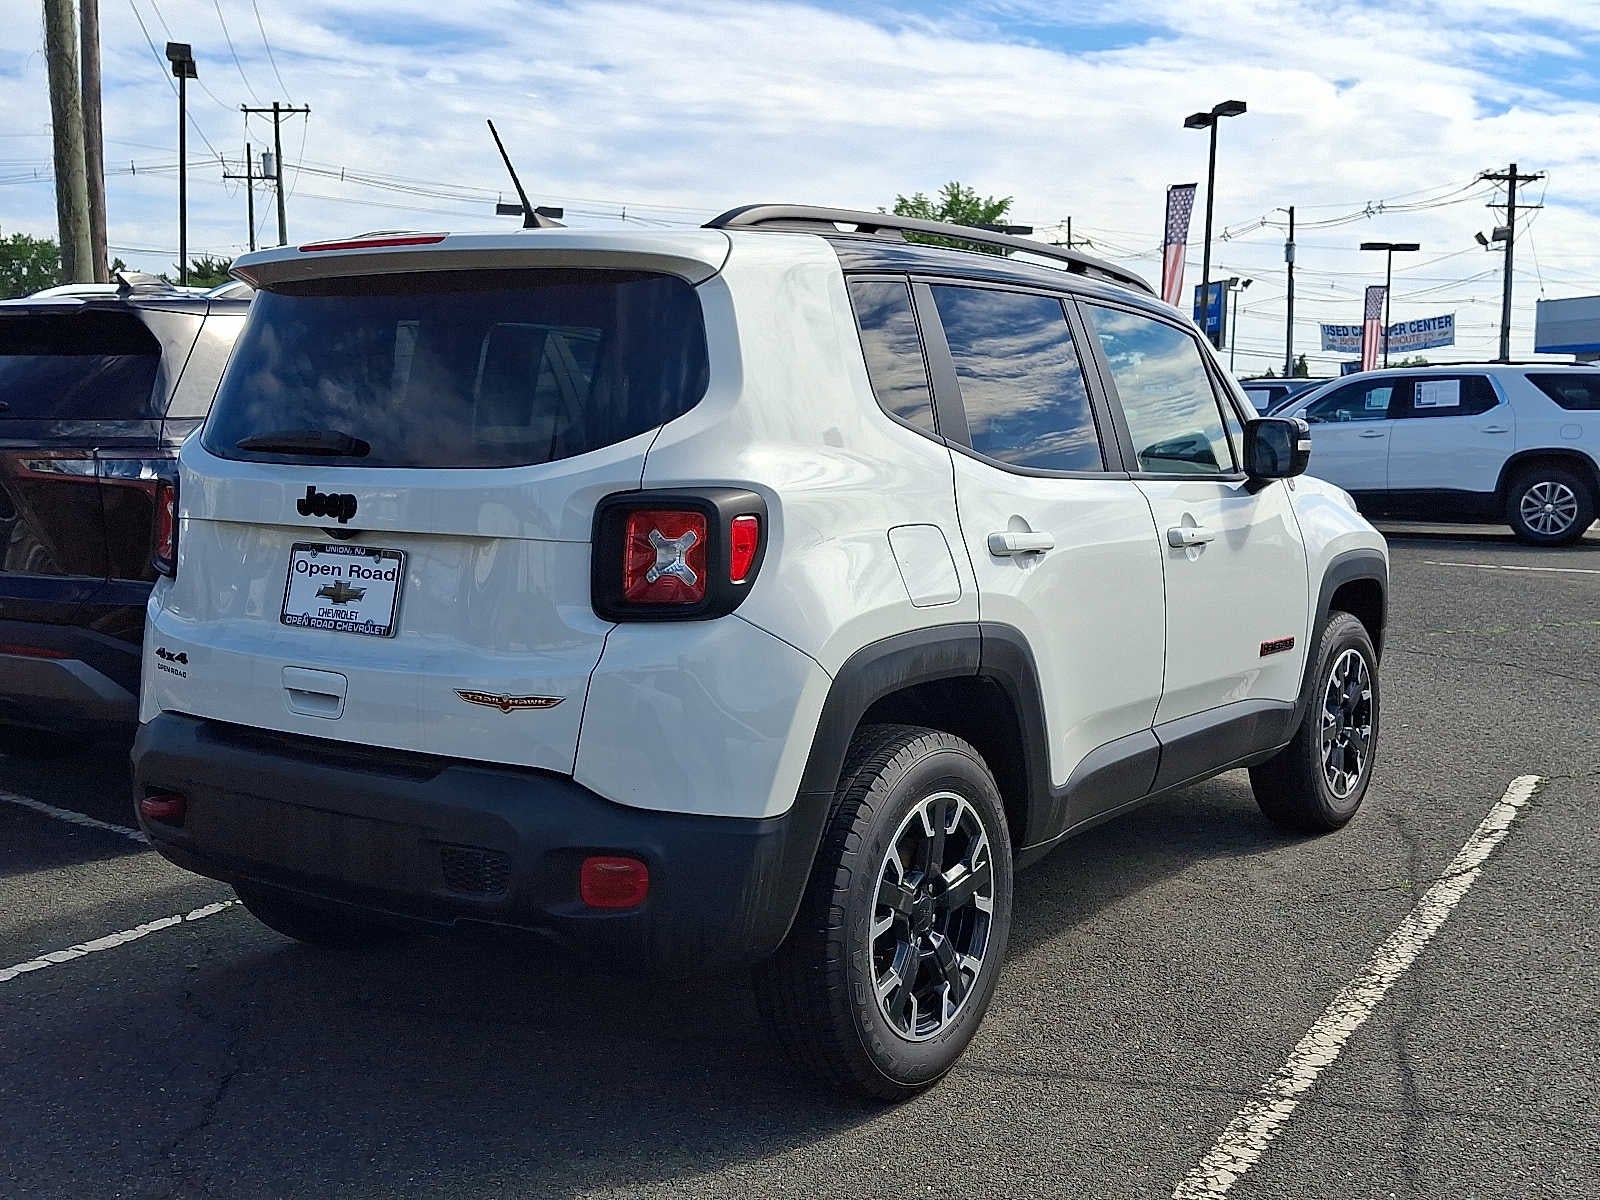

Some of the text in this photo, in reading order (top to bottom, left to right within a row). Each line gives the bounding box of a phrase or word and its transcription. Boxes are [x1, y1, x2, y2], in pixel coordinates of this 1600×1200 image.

[1322, 325, 1349, 337] USED
[1409, 314, 1453, 334] CENTER
[296, 485, 358, 524] Jeep
[325, 545, 366, 556] UNION, NJ
[295, 559, 397, 582] Open Road
[317, 607, 360, 621] CHEVROLET
[285, 615, 386, 636] OPEN ROAD CHEVROLET
[155, 647, 189, 665] 4x4
